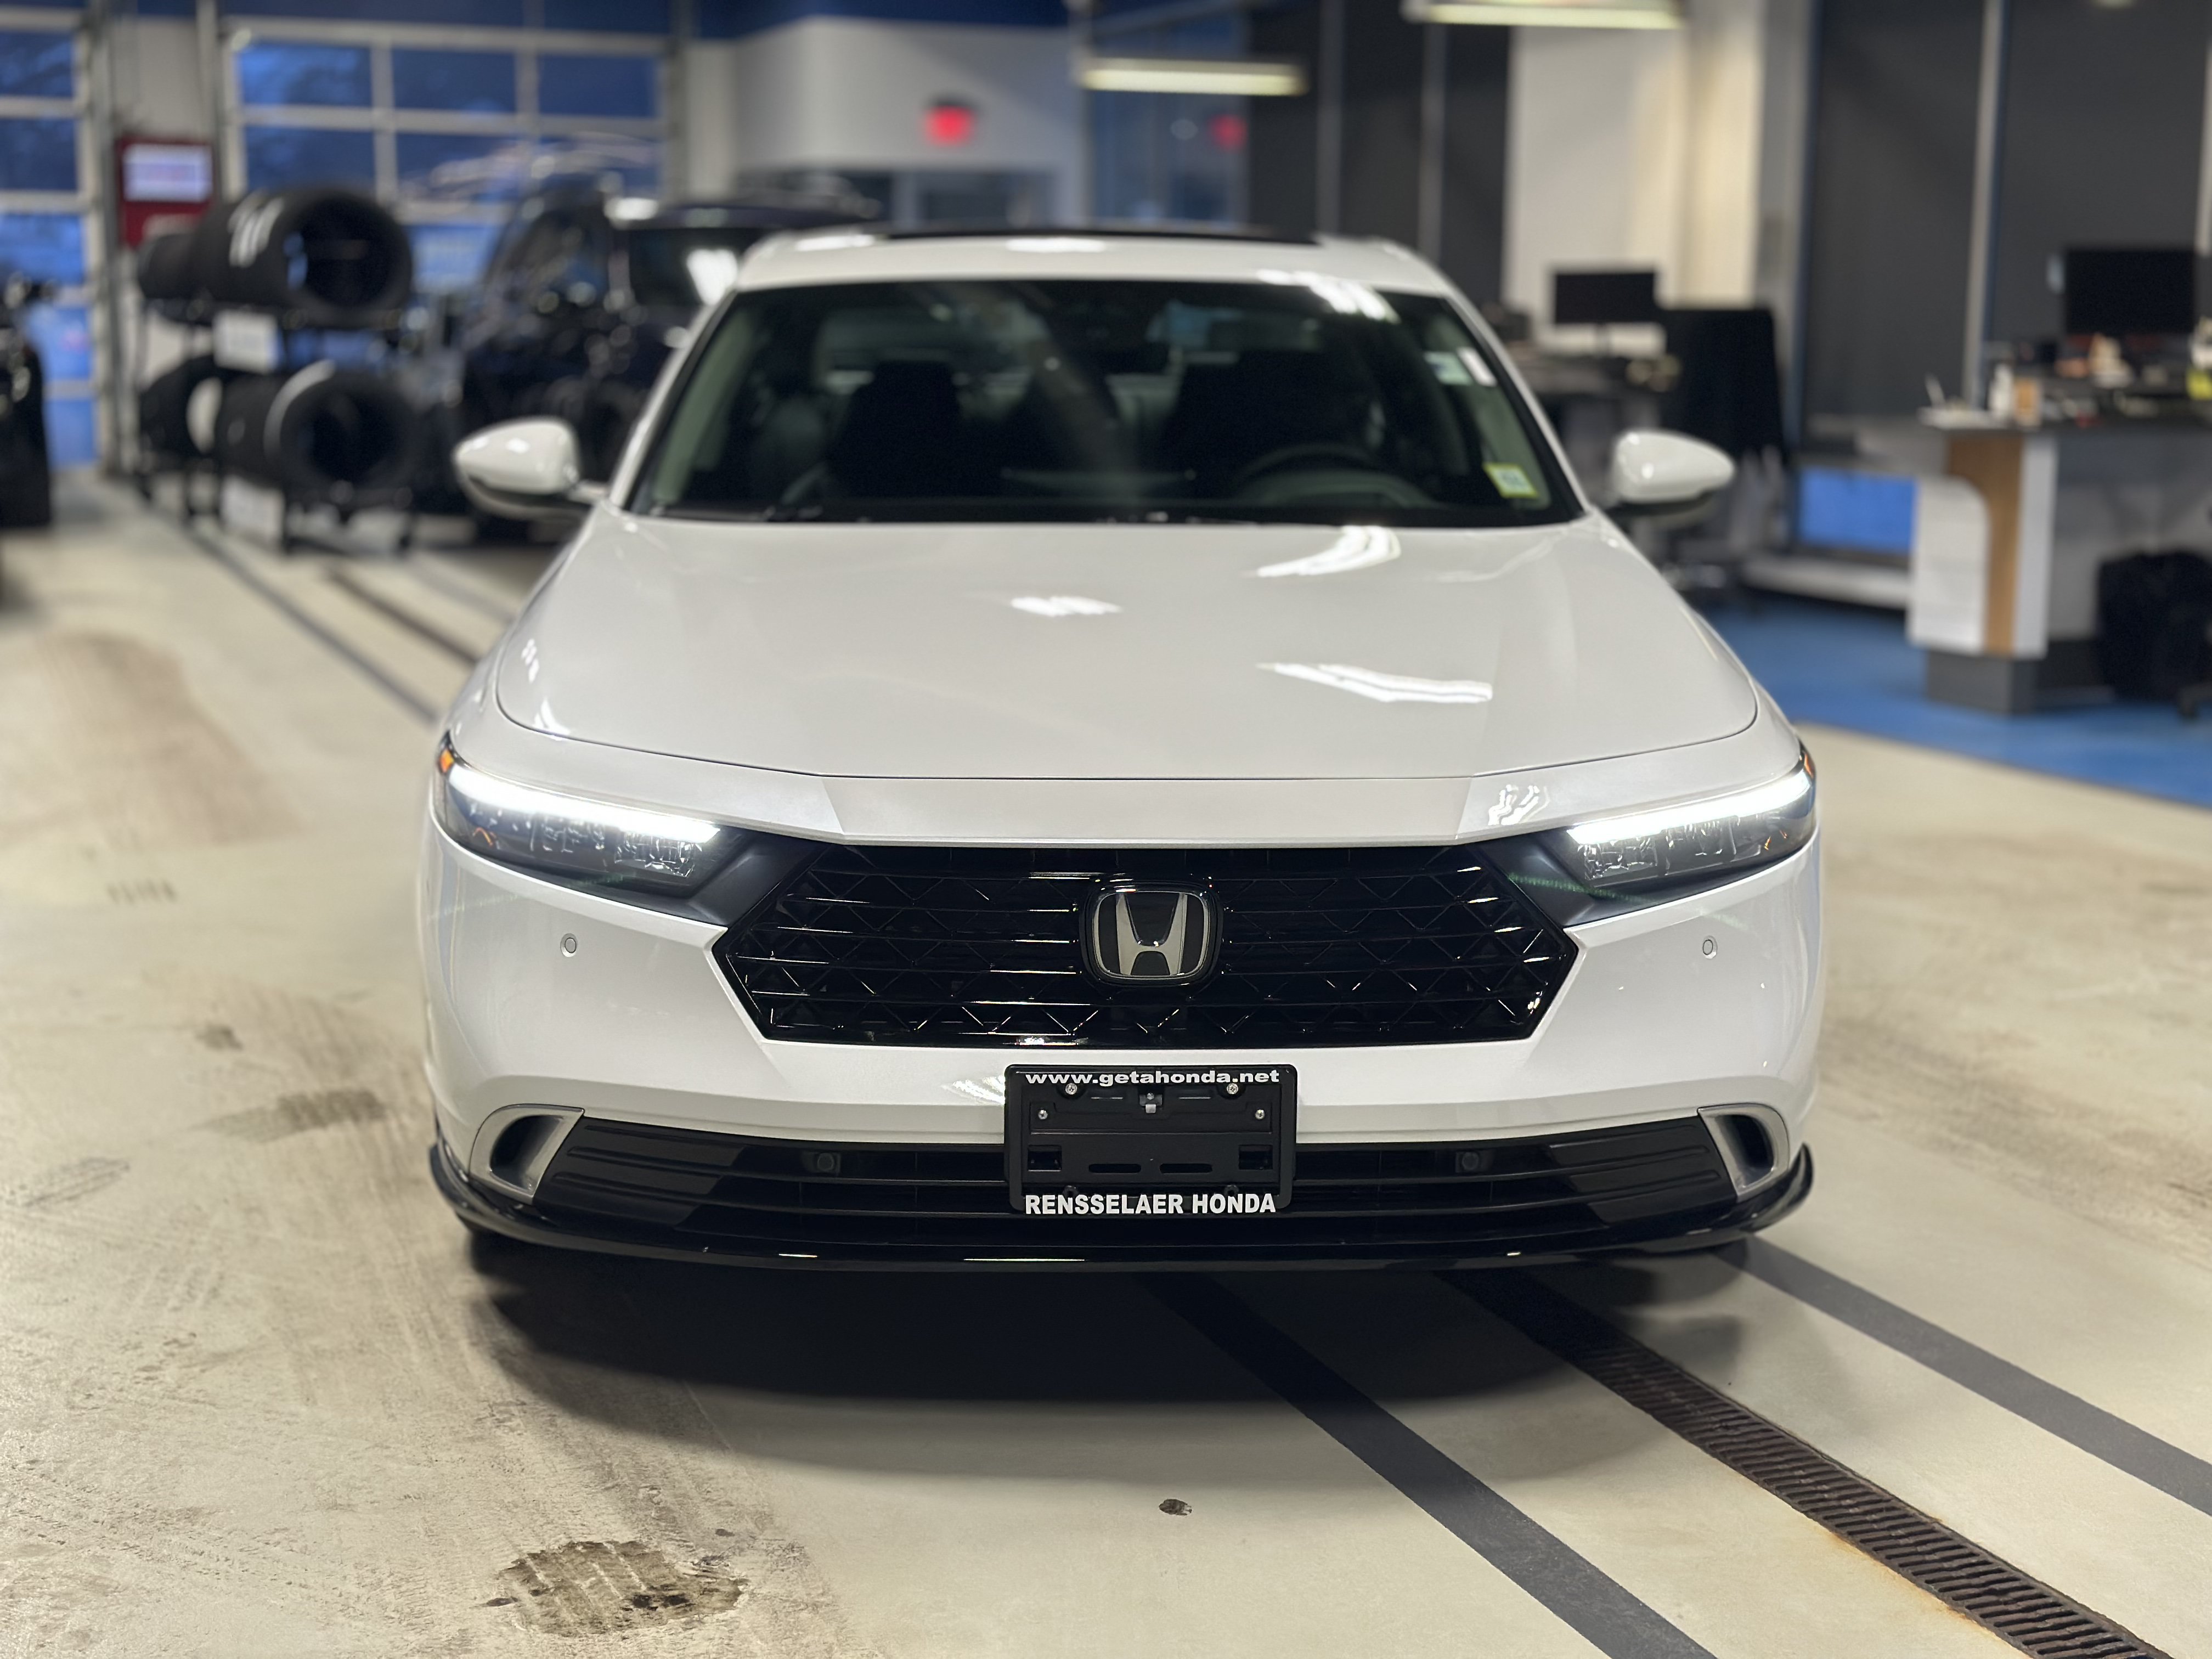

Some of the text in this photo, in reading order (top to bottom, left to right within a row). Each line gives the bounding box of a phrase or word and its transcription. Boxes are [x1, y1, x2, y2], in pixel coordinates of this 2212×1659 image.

[1025, 1070, 1280, 1087] www.getahonda.net
[1025, 1193, 1276, 1215] RENSSELAER HONDA
